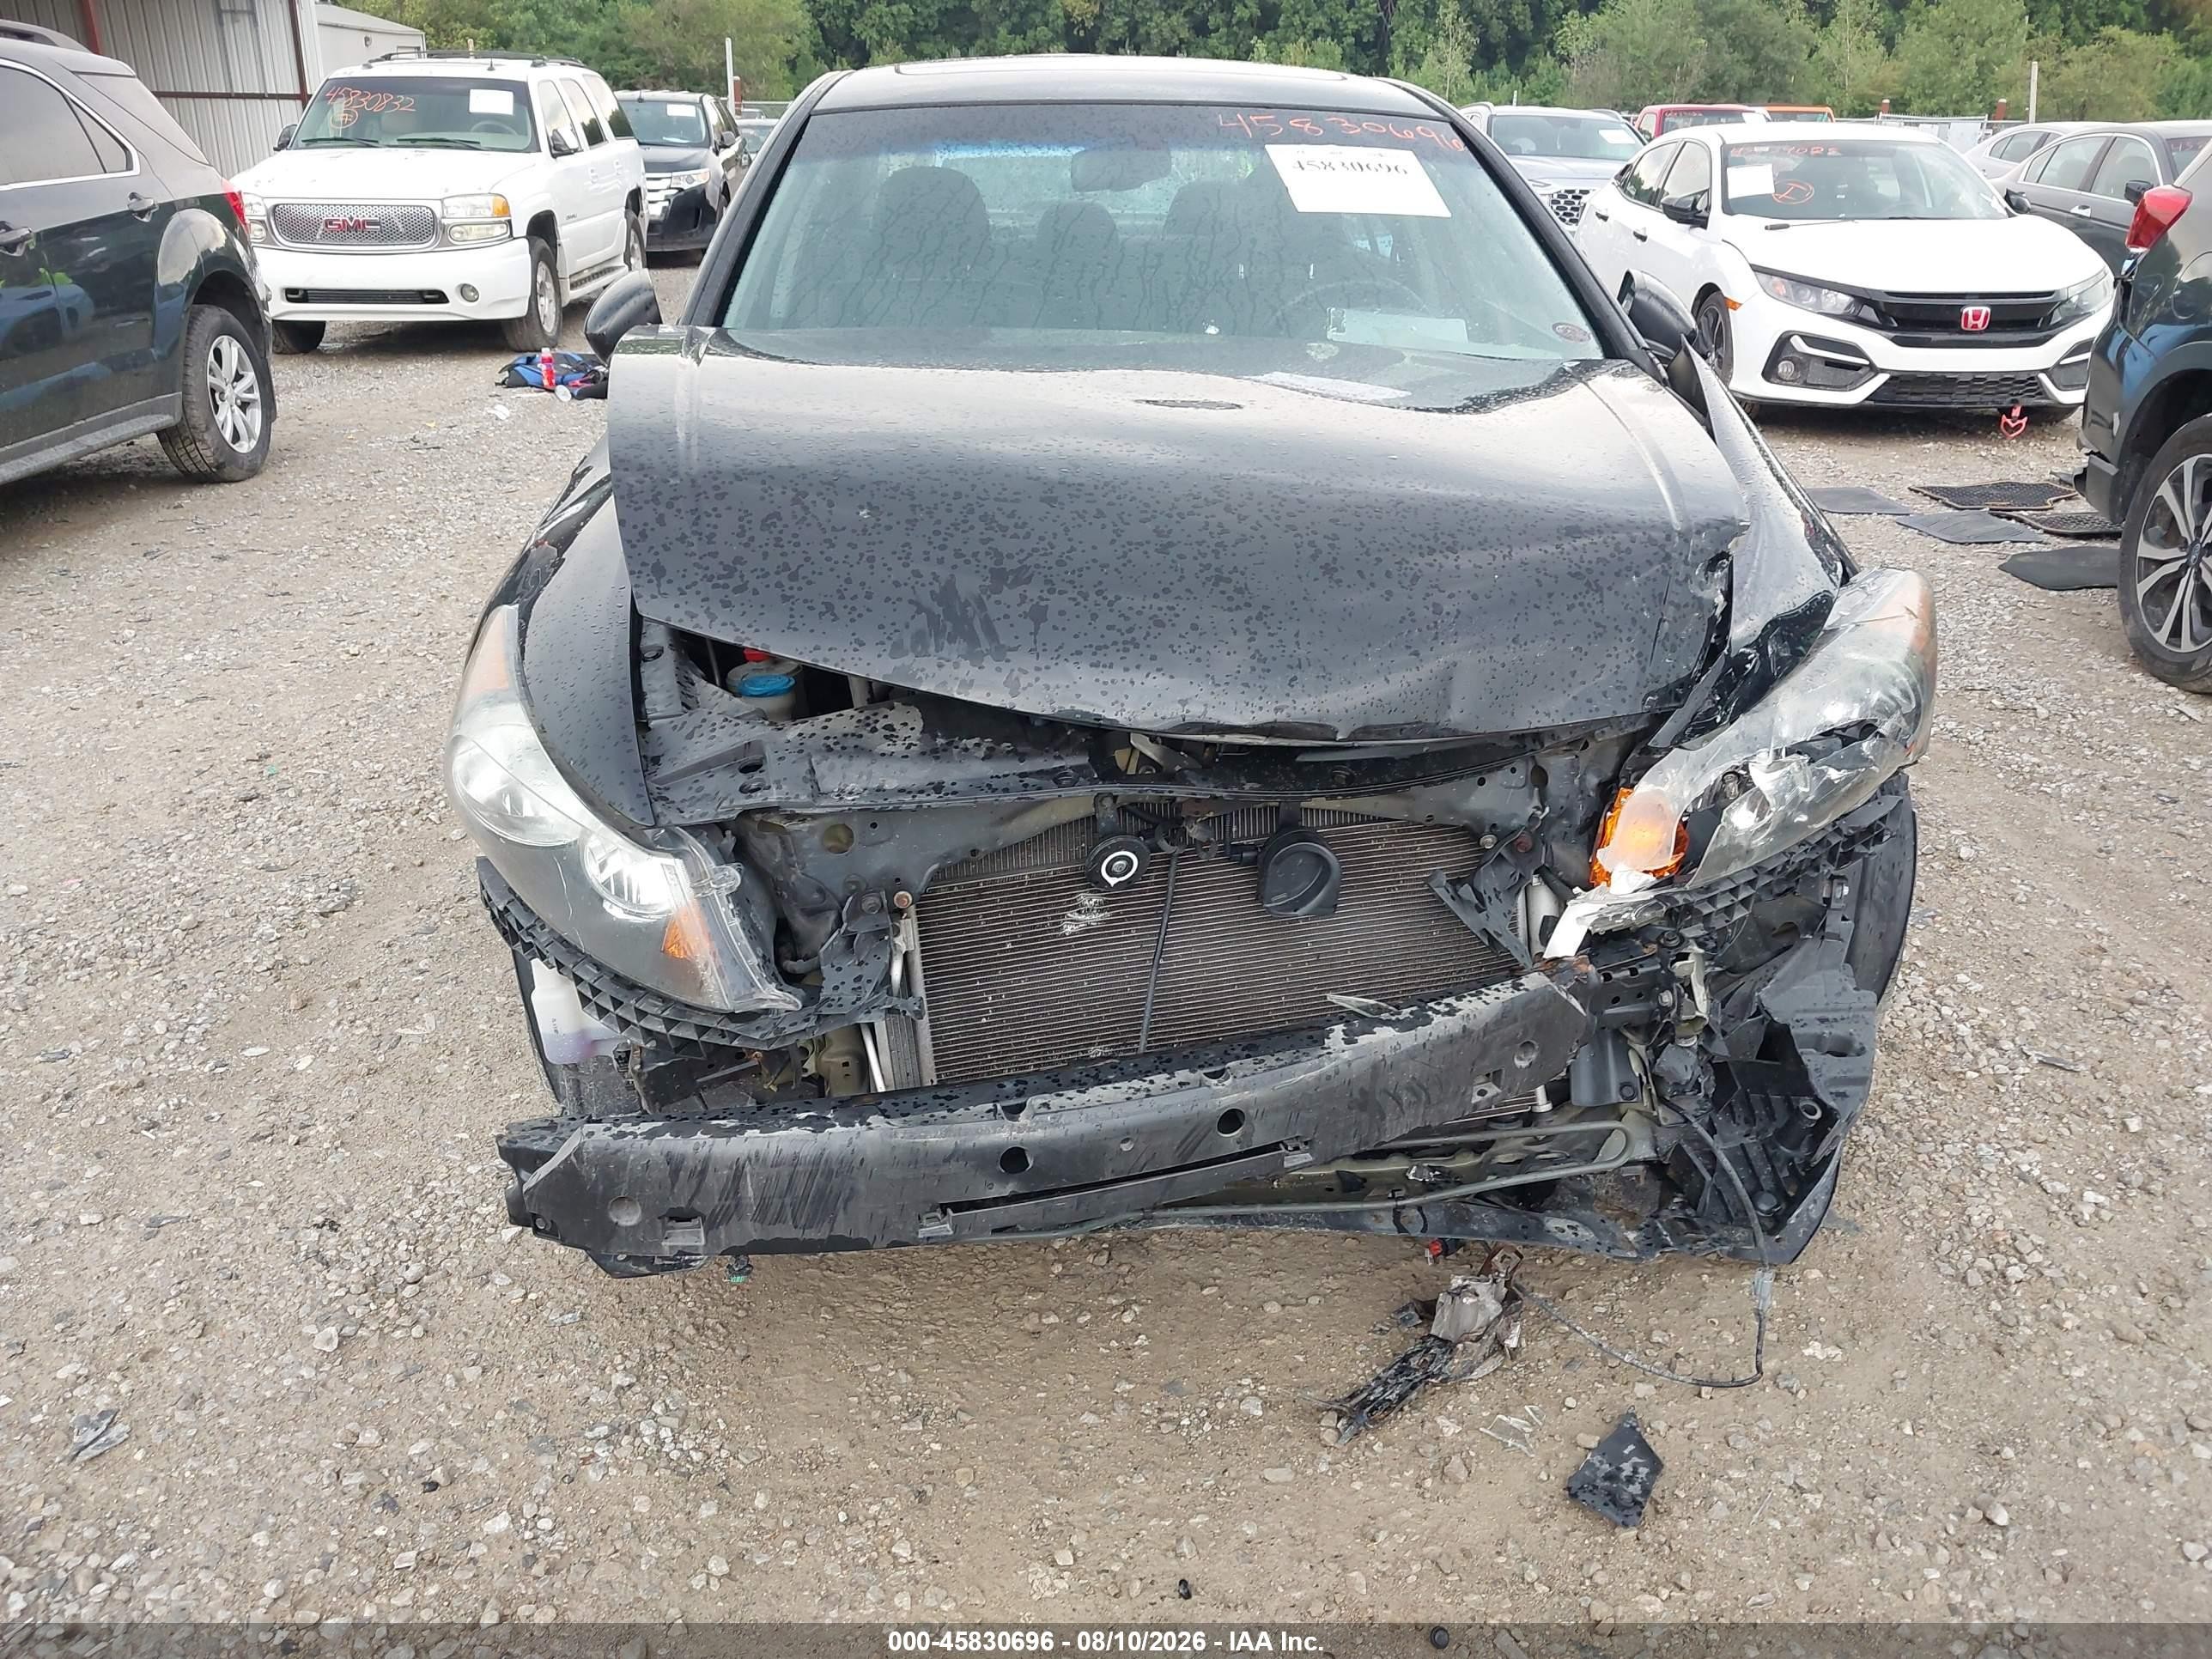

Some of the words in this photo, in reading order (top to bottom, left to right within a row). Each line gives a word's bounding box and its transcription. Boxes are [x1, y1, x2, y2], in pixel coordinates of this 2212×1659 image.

[325, 86, 416, 113] 45830832
[1218, 112, 1466, 152] 45830696
[1291, 159, 1409, 176] 45830696
[323, 216, 382, 232] GMC
